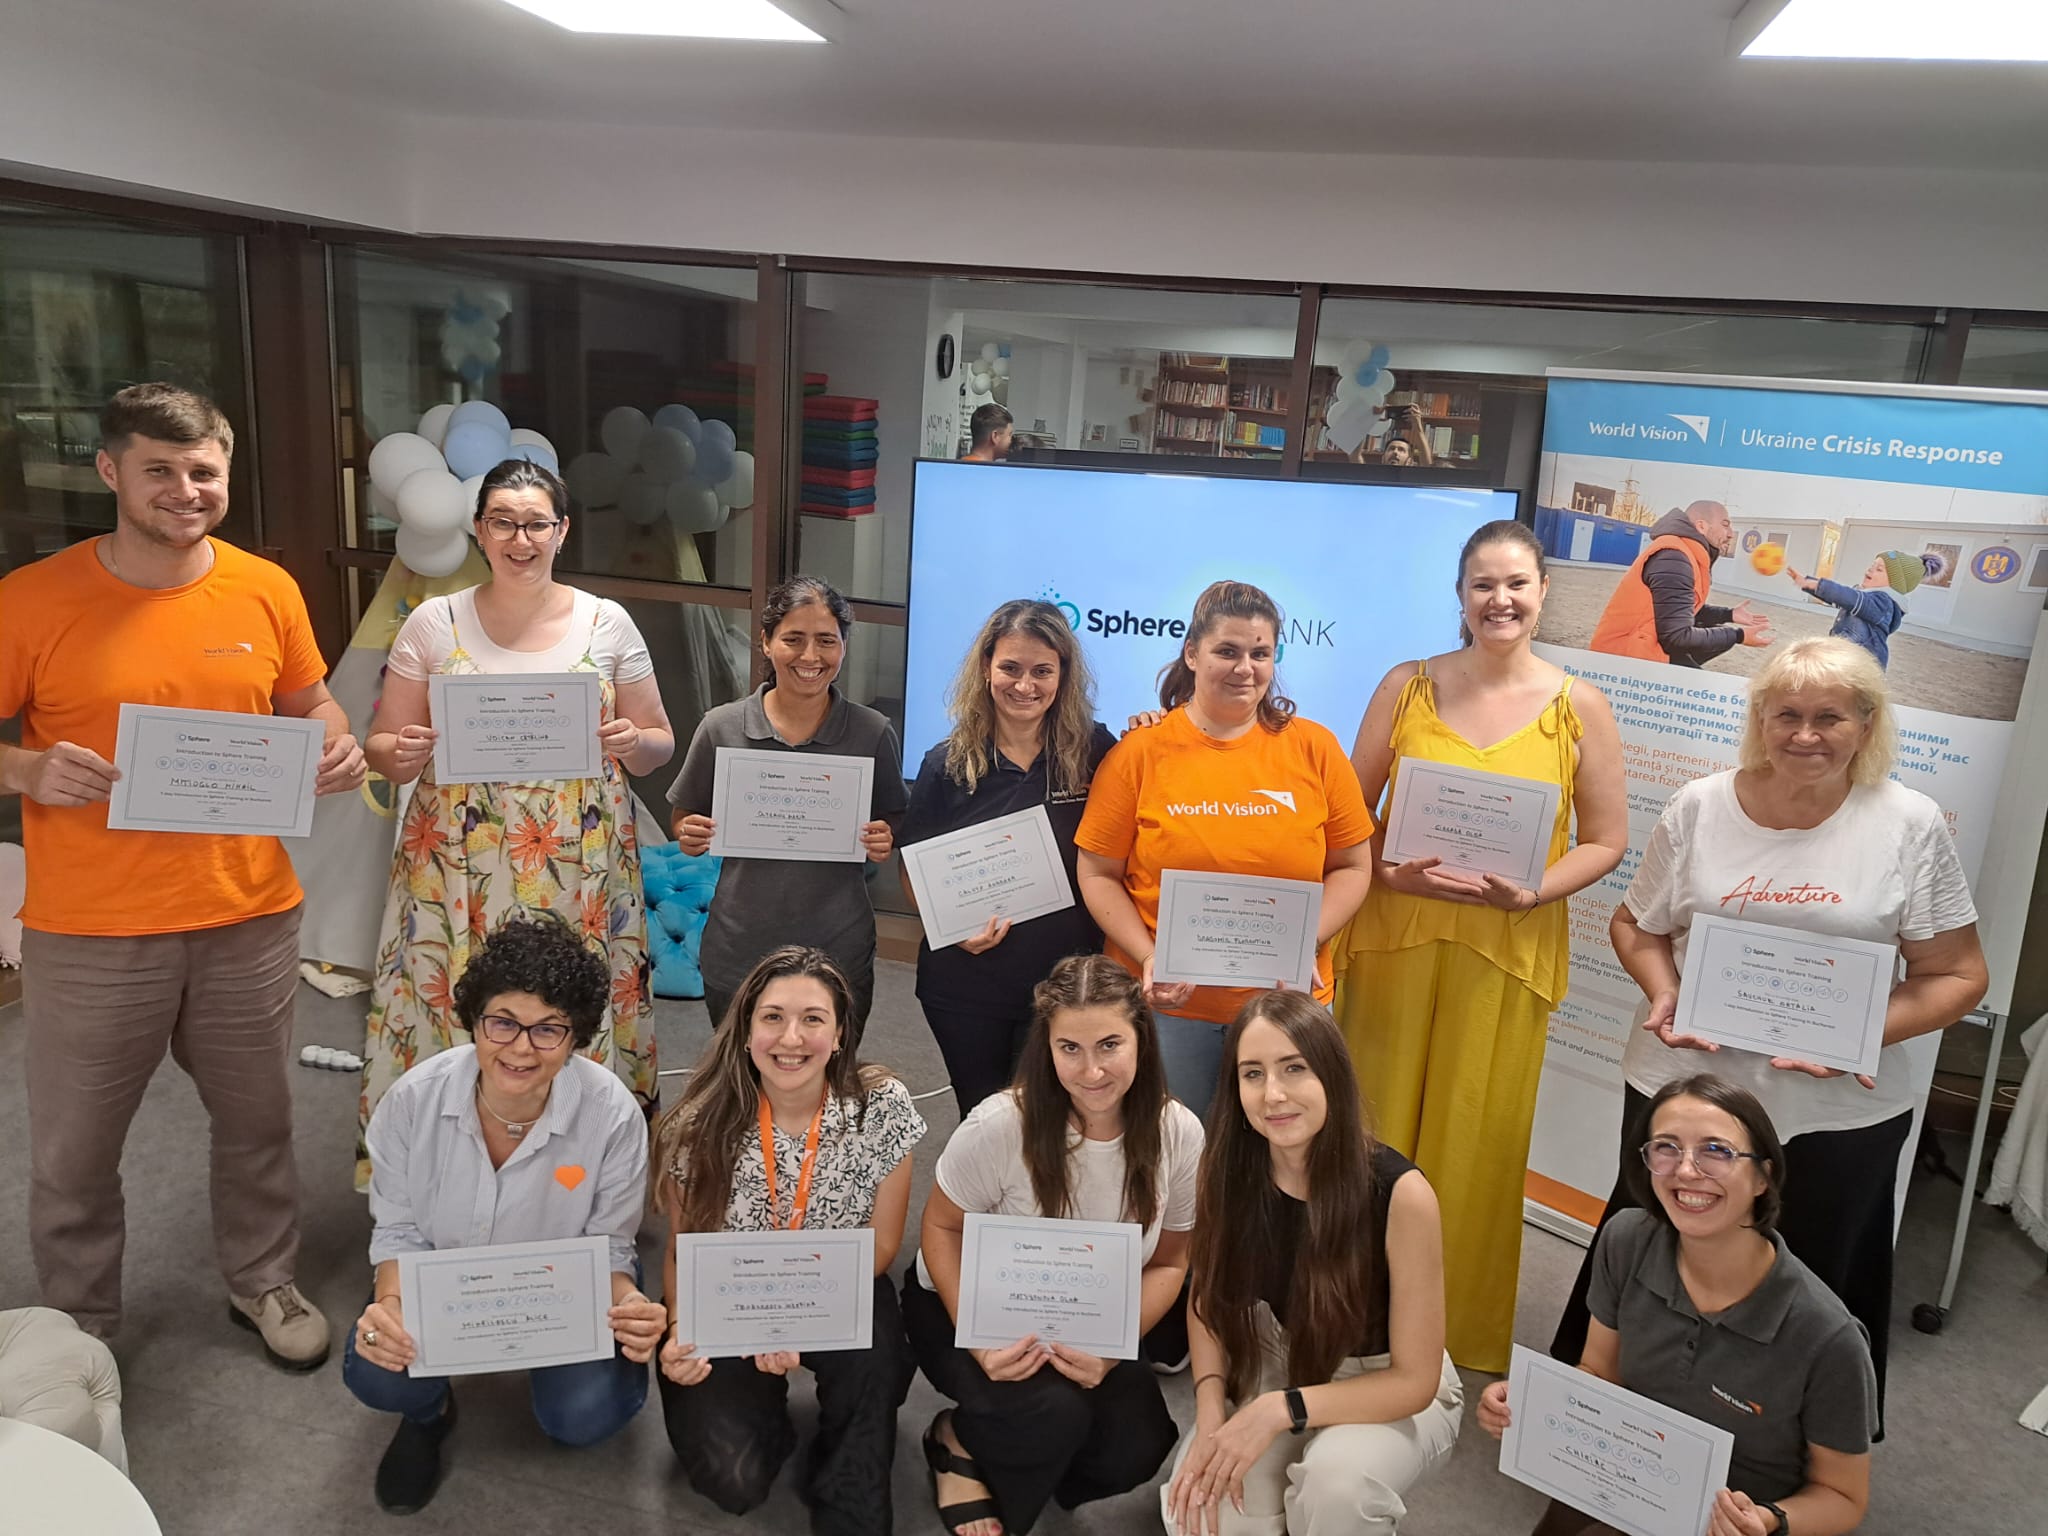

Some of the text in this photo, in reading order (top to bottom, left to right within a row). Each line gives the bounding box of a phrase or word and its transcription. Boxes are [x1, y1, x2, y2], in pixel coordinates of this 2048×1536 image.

[1589, 421, 1688, 442] World Vision
[1741, 428, 2003, 466] Ukraine Crisis Response
[1087, 608, 1186, 639] Sphere
[1581, 669, 1618, 684] маєте
[1620, 676, 1684, 696] відчувати
[1686, 686, 1717, 702] себе
[1719, 693, 1727, 703] в
[1730, 693, 1747, 708] бе
[1615, 689, 1728, 719] співробітниками,
[1731, 710, 1746, 721] па
[1616, 703, 1674, 720] нульової
[1676, 713, 1745, 734] терпимос
[1622, 716, 1741, 748] експлуатації та жо
[1898, 728, 1950, 746] аними
[1620, 740, 1649, 757] legii,
[1652, 748, 1710, 768] partenerii
[1899, 743, 1925, 757] ми.
[1942, 752, 1970, 765] нас
[1623, 757, 1662, 772] uranță
[1676, 768, 1710, 781] respe
[1897, 758, 1938, 776] ьної,
[1659, 774, 1688, 789] fizic
[1166, 800, 1278, 817] World Vision
[1644, 807, 1663, 816] emo
[1568, 895, 1611, 912] inciple:
[1720, 875, 1843, 915] Adventure
[1568, 905, 1611, 924] unde ve
[1575, 920, 1605, 934] primi
[1578, 933, 1592, 943] ne
[1591, 957, 1600, 966] to
[1600, 961, 1626, 974] assist
[1602, 970, 1611, 978] to
[1568, 1042, 1584, 1053] and
